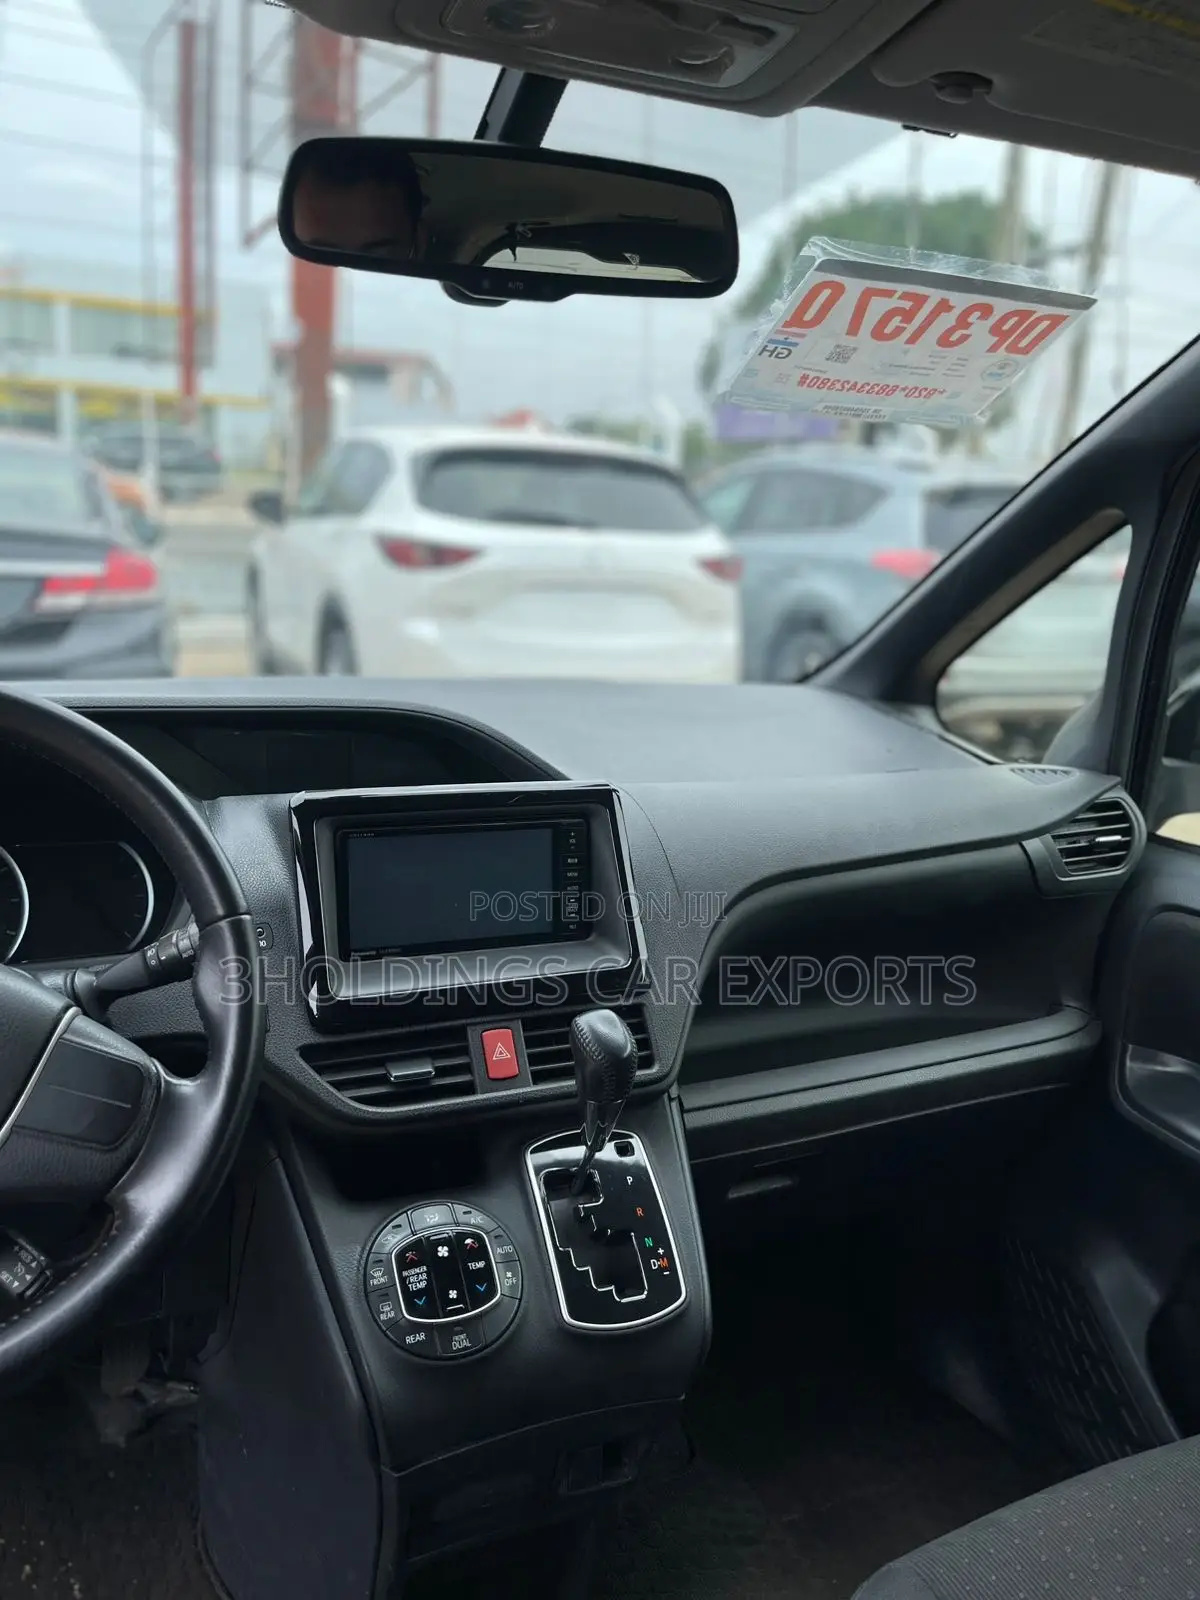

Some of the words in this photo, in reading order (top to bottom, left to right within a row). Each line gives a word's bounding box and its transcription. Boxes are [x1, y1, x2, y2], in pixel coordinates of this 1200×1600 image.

[626, 1175, 633, 1185] P
[636, 1207, 644, 1217] R
[470, 1216, 485, 1225] A/C
[644, 1237, 653, 1248] N
[496, 1245, 513, 1255] AUTO
[402, 1265, 428, 1277] PASSENGER
[467, 1260, 486, 1271] TEMP
[370, 1275, 389, 1287] FRONT
[408, 1280, 428, 1292] TEMP
[504, 1278, 518, 1287] OFF
[380, 1311, 396, 1321] REAR
[405, 1332, 426, 1345] REAR
[451, 1338, 472, 1351] DUAL
